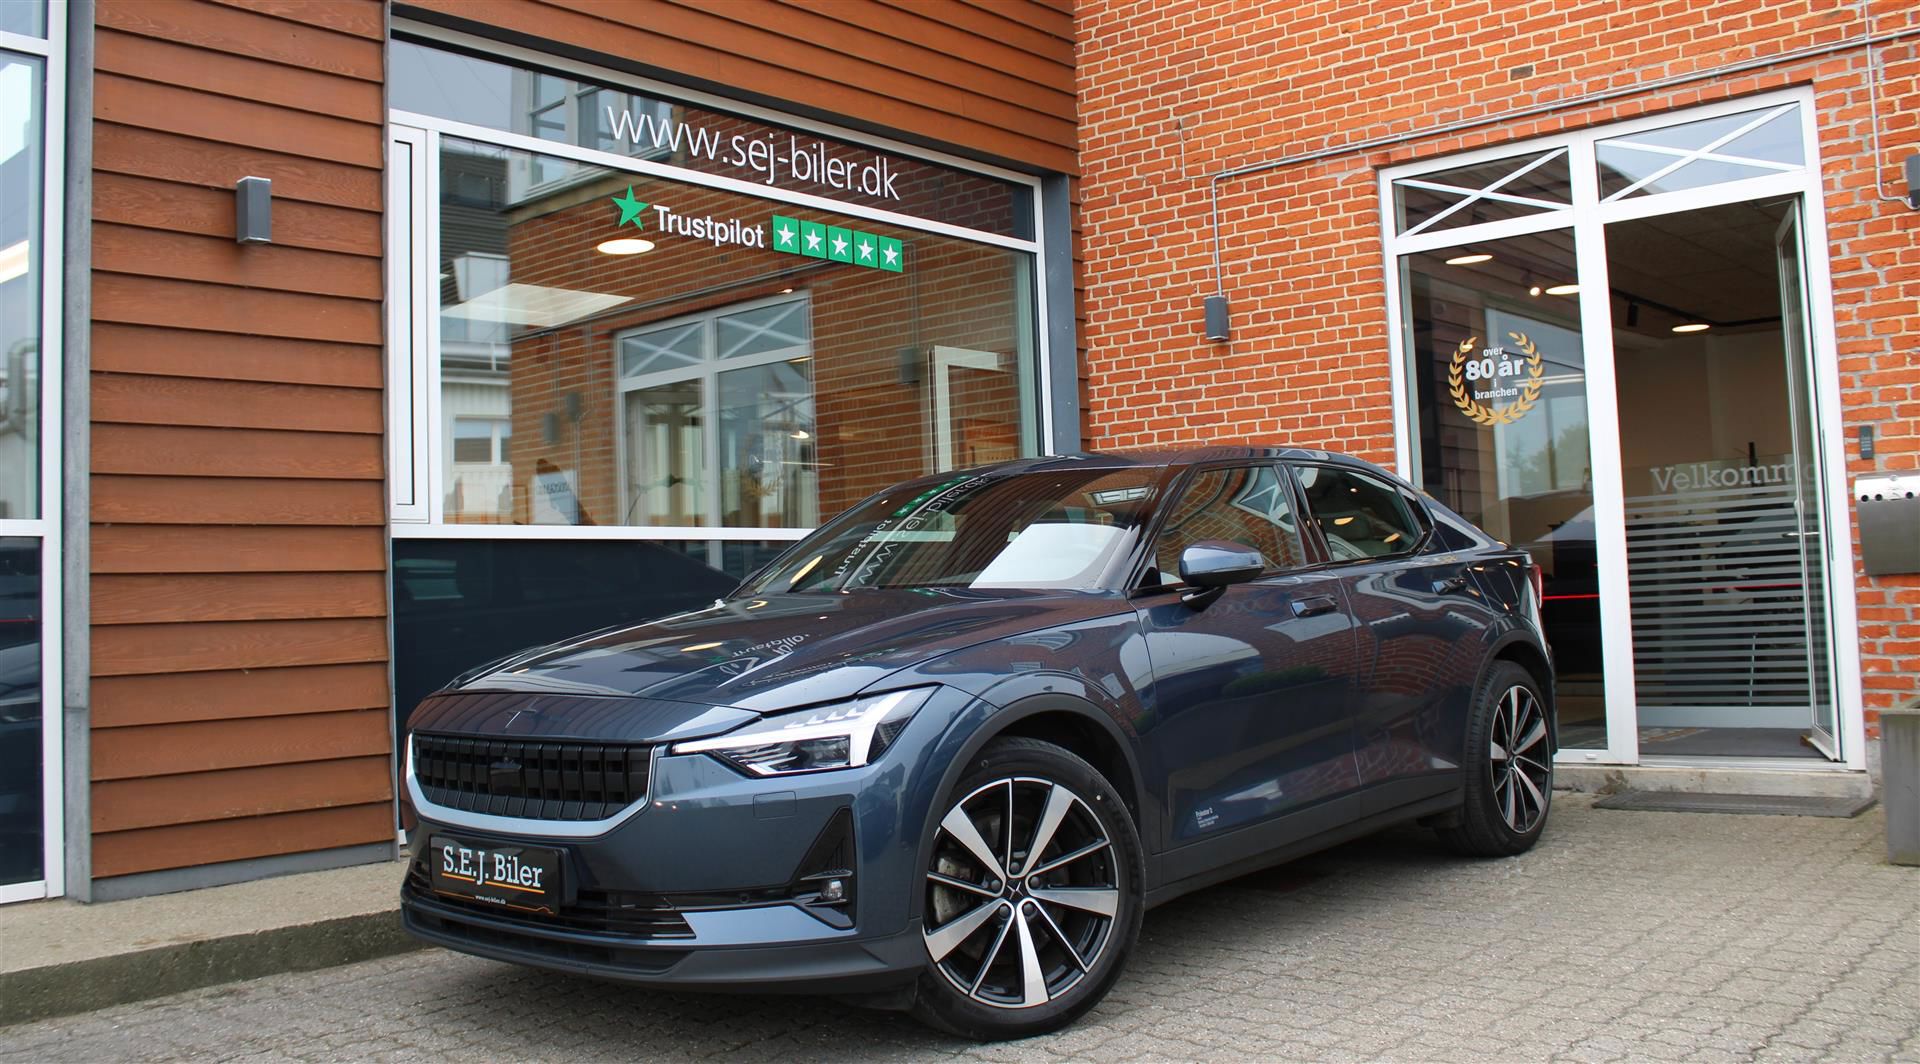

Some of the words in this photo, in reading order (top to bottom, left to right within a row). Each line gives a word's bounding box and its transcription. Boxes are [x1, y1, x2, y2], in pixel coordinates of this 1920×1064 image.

[607, 105, 901, 201] www.sej-biler.dk
[653, 205, 765, 249] Trustpilot
[1465, 358, 1495, 381] 80
[1498, 354, 1524, 377] år
[1482, 346, 1504, 357] over
[1474, 387, 1518, 400] branchen
[443, 845, 489, 885] S.E.J.
[493, 853, 543, 888] Biler
